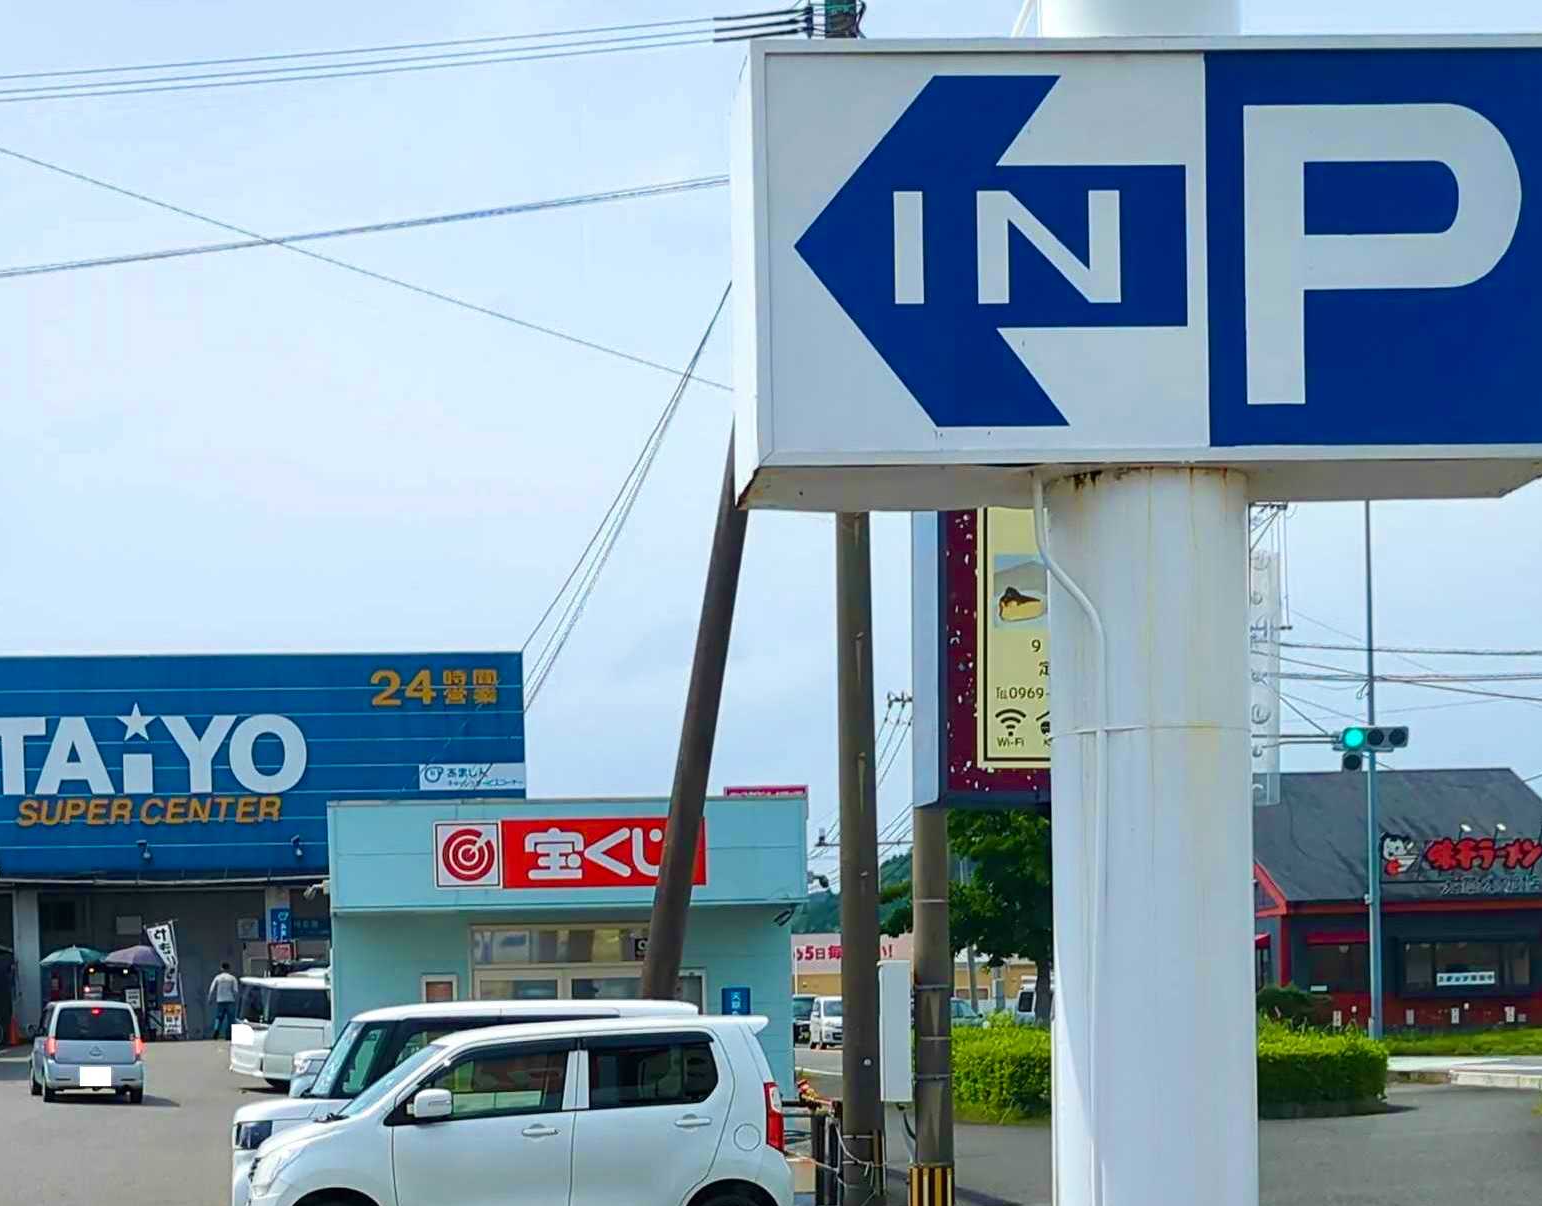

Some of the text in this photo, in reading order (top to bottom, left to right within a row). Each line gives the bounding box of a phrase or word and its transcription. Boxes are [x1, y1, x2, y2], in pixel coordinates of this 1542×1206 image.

[893, 190, 1121, 304] IN
[1243, 102, 1522, 405] P
[370, 669, 437, 706] 24
[17, 795, 283, 827] SUPER CENTER
[523, 827, 664, 880] 宝くじ
